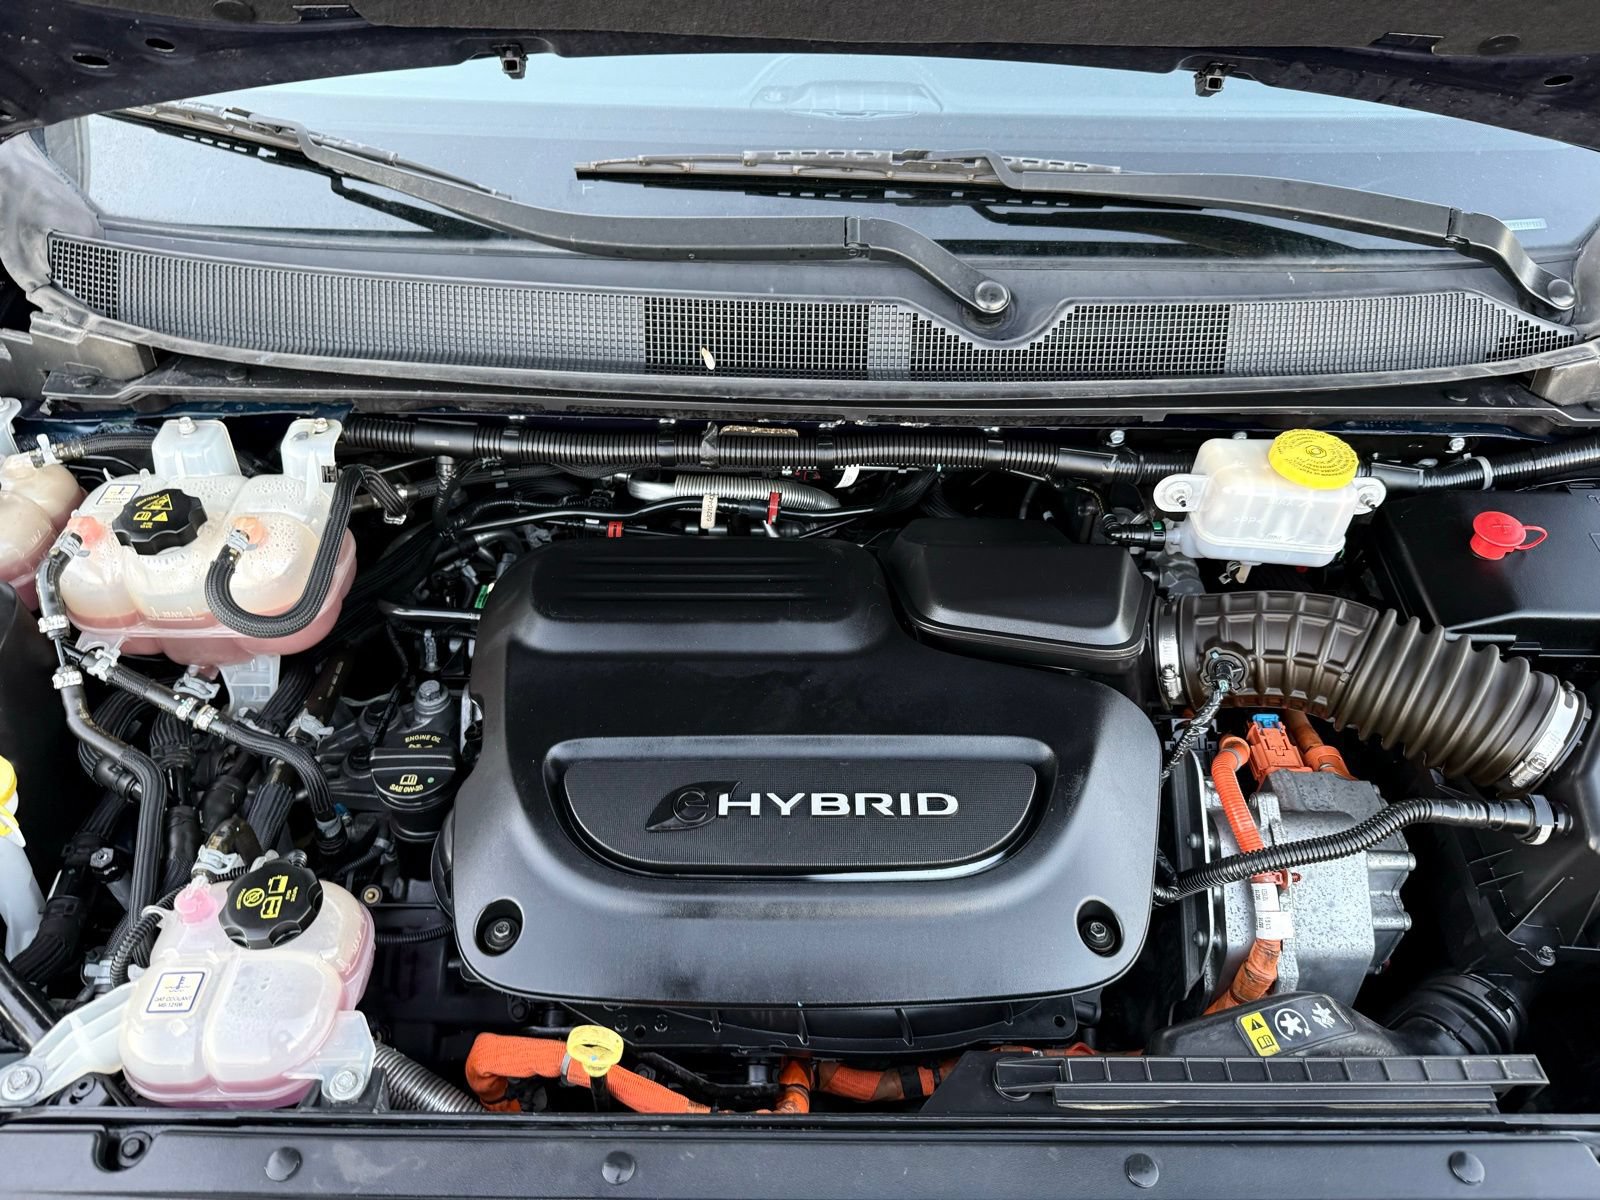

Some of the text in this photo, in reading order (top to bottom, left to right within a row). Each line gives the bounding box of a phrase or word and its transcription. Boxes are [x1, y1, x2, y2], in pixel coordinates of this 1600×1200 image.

[405, 734, 441, 743] ENGINE OIL
[389, 784, 403, 793] SAE
